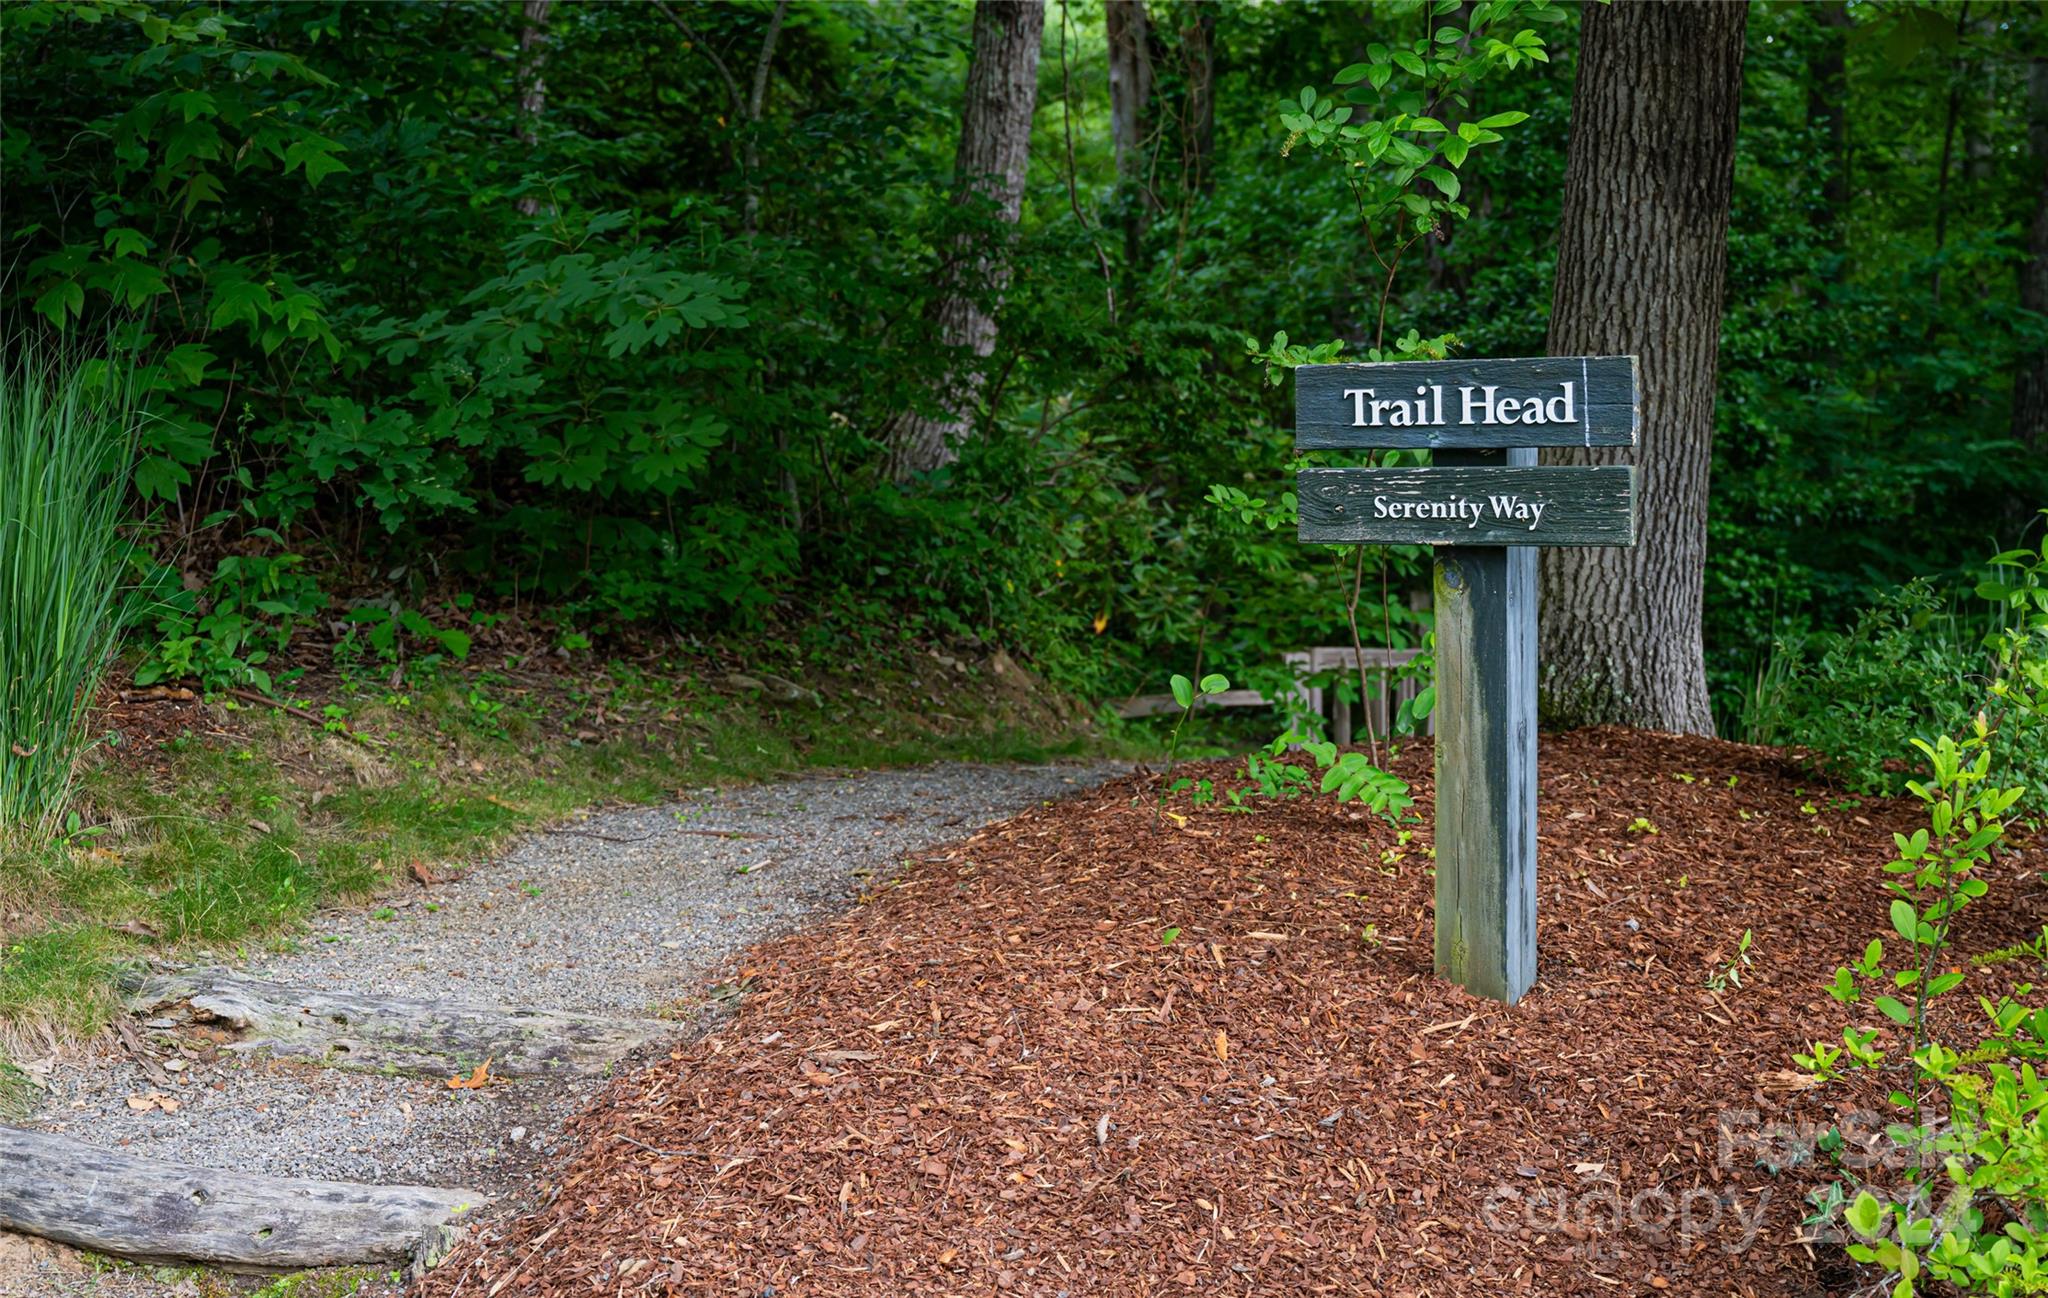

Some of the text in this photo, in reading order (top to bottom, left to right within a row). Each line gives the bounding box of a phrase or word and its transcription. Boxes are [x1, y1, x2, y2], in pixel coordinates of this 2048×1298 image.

[1344, 381, 1578, 427] Trail Head
[1373, 494, 1546, 530] Serenity Way
